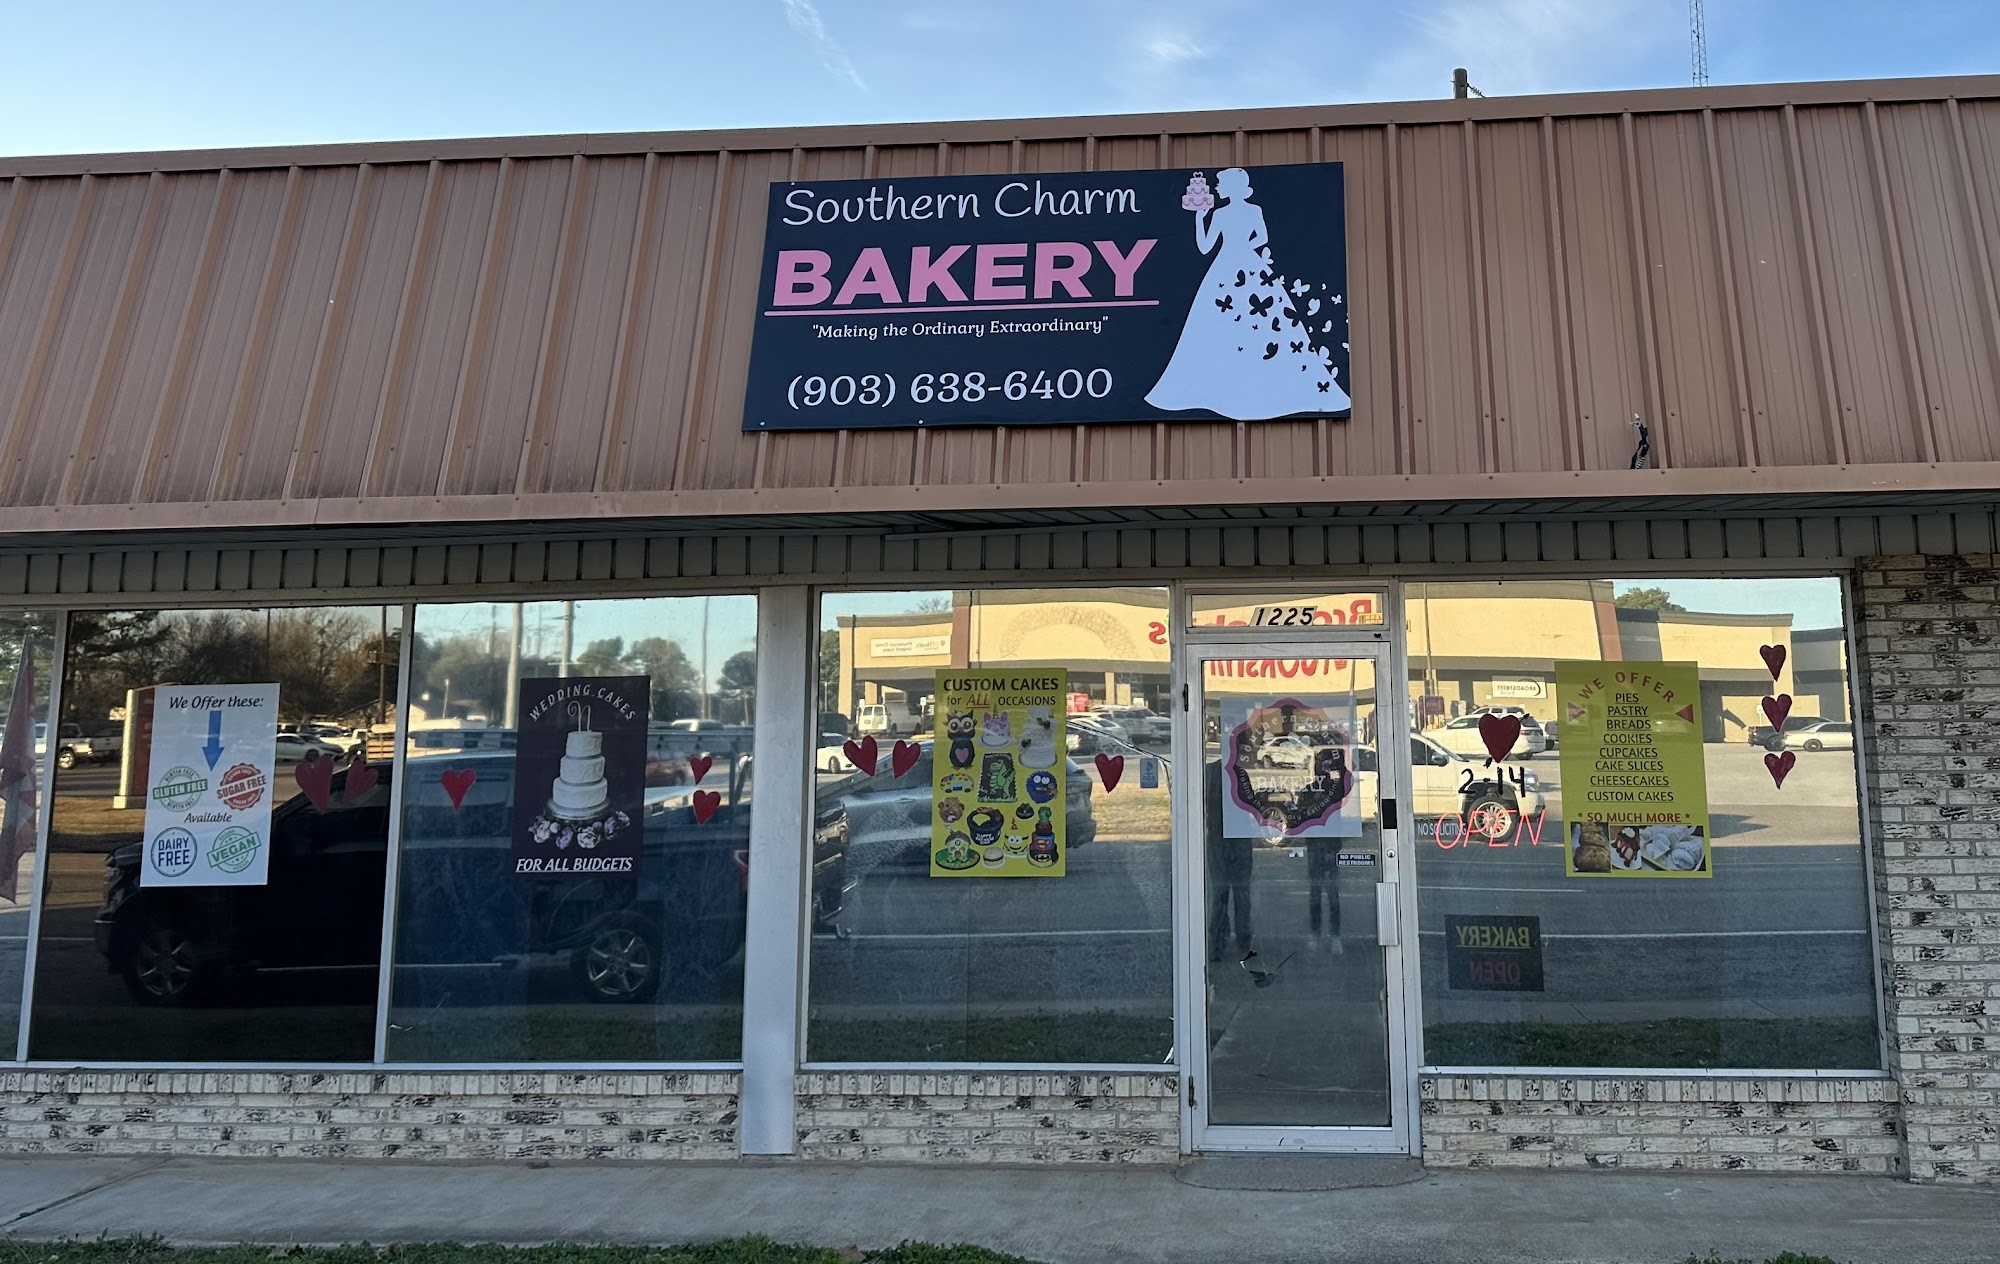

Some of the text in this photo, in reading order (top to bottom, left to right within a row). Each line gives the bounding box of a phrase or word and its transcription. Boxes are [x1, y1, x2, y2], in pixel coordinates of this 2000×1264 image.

[782, 181, 1141, 227] Southern Charm
[772, 239, 1158, 307] BAKERY
[812, 315, 1109, 341] "Making the Ordinary Extraordinary"
[786, 368, 1113, 409] (903) 638-6400
[1255, 607, 1314, 627] 1225
[943, 677, 1059, 692] CUSTOM CAKES
[1579, 671, 1675, 703] WE OFFER
[169, 696, 264, 710] We Offer these:
[529, 684, 636, 722] WEDDING CAKES
[946, 693, 1056, 708] for ALL OCCASIONS
[1615, 693, 1639, 703] PIES
[1607, 705, 1648, 716] PASTRY
[1606, 719, 1651, 730] BREADS
[1240, 713, 1298, 763] Southern
[1603, 733, 1652, 744] COOKIES
[1599, 747, 1658, 758] CUPCAKES
[1595, 760, 1664, 771] CAKE SLICES
[216, 774, 267, 799] SUGAR FREE
[1254, 774, 1327, 793] BAKERY
[1458, 766, 1526, 798] 2-14
[1590, 775, 1669, 786] CHEESECAKES
[153, 779, 208, 798] GLUTEN FREE
[1587, 791, 1674, 802] CUSTOM CAKES
[184, 812, 233, 823] Available
[1587, 812, 1682, 823] SO MUCH MORE
[1417, 823, 1430, 836] NO
[1435, 808, 1546, 849] OPEN
[158, 837, 190, 851] DAIRY
[211, 836, 257, 863] VEGAN
[158, 849, 190, 867] FREE
[514, 857, 634, 872] FOR ALL BUDGETS
